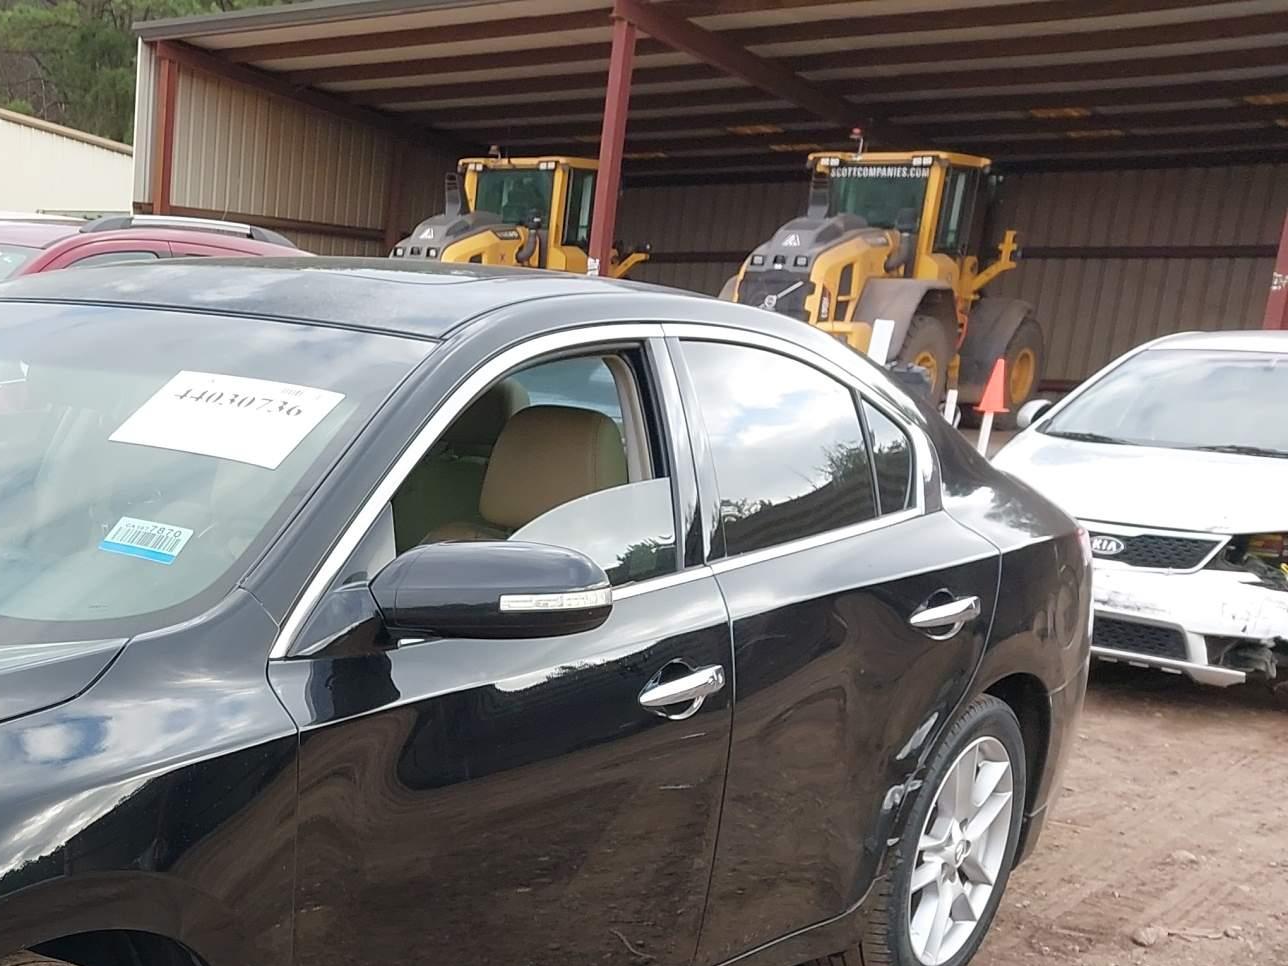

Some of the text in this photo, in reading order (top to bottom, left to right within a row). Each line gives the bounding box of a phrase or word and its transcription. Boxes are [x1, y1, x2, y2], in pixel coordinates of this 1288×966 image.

[830, 166, 930, 178] SCOTTCOMPANIES.COM
[172, 388, 303, 417] 44030736
[1092, 538, 1117, 552] KIA
